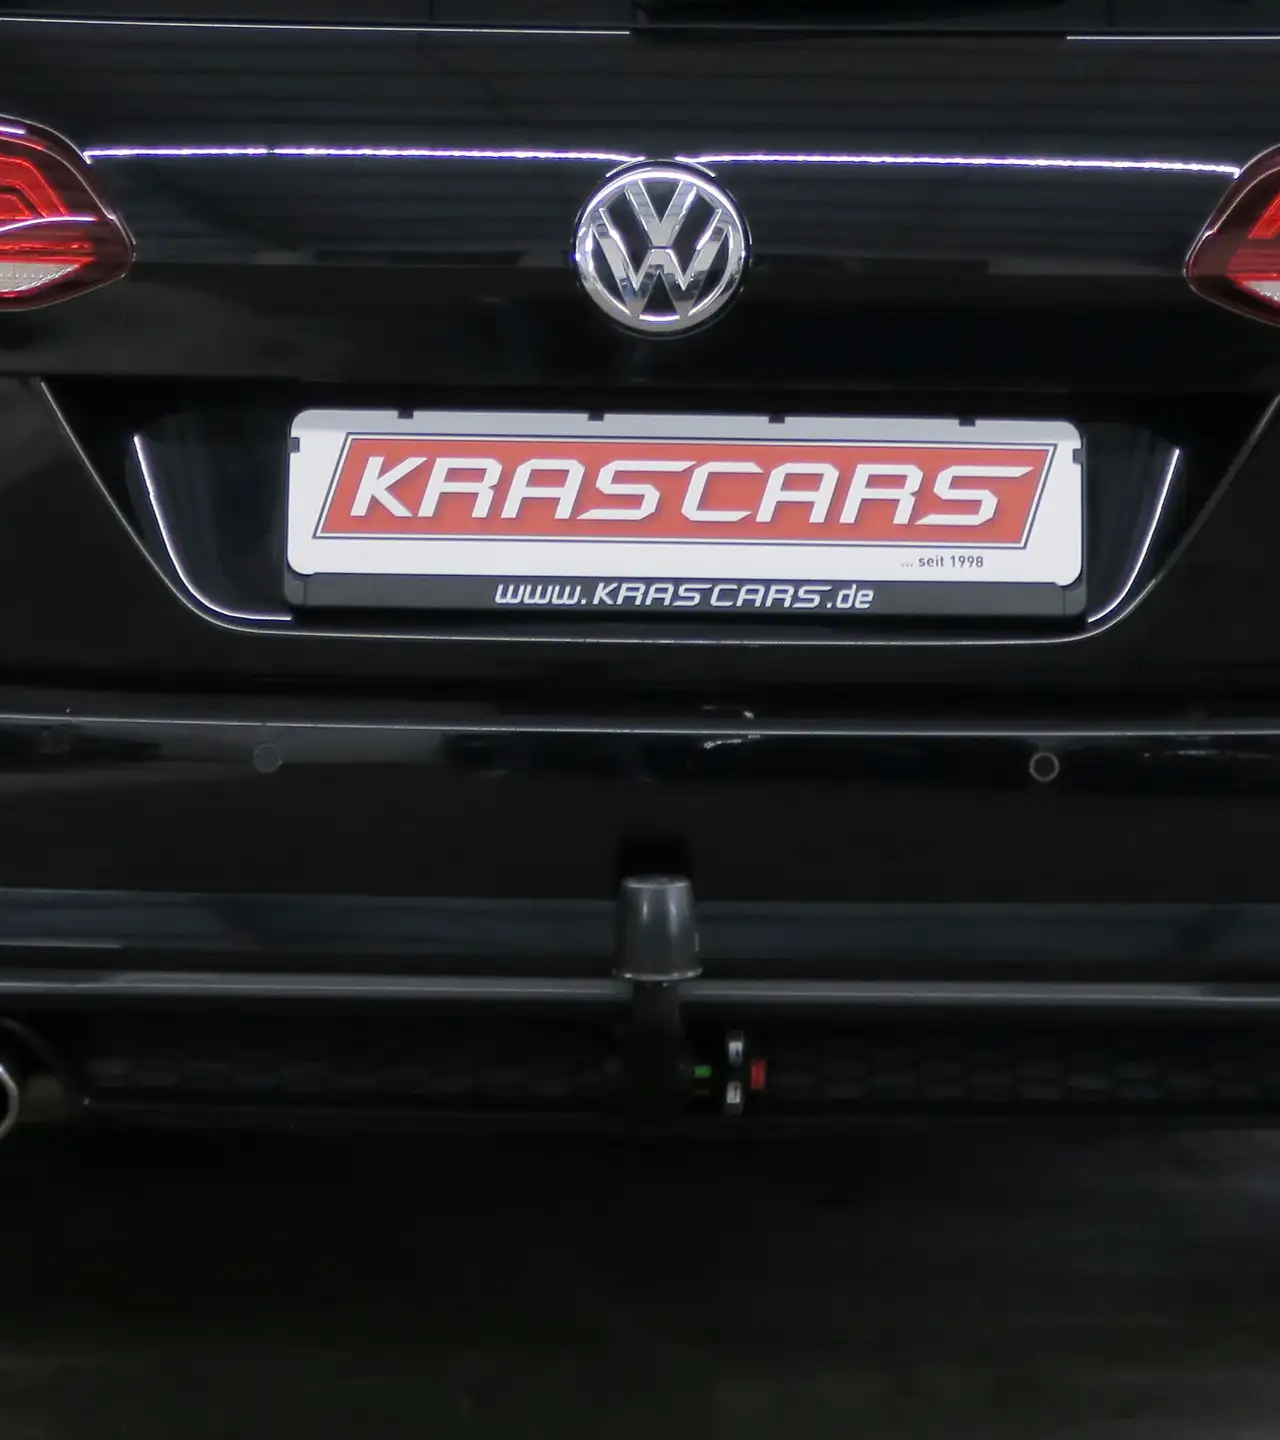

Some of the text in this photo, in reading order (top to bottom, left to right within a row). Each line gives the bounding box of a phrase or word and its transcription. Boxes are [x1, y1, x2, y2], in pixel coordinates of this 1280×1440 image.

[350, 455, 1035, 527] KRASCARS
[918, 555, 945, 568] seit
[949, 555, 985, 569] 1998
[494, 581, 874, 610] www.KRASCARS.de
